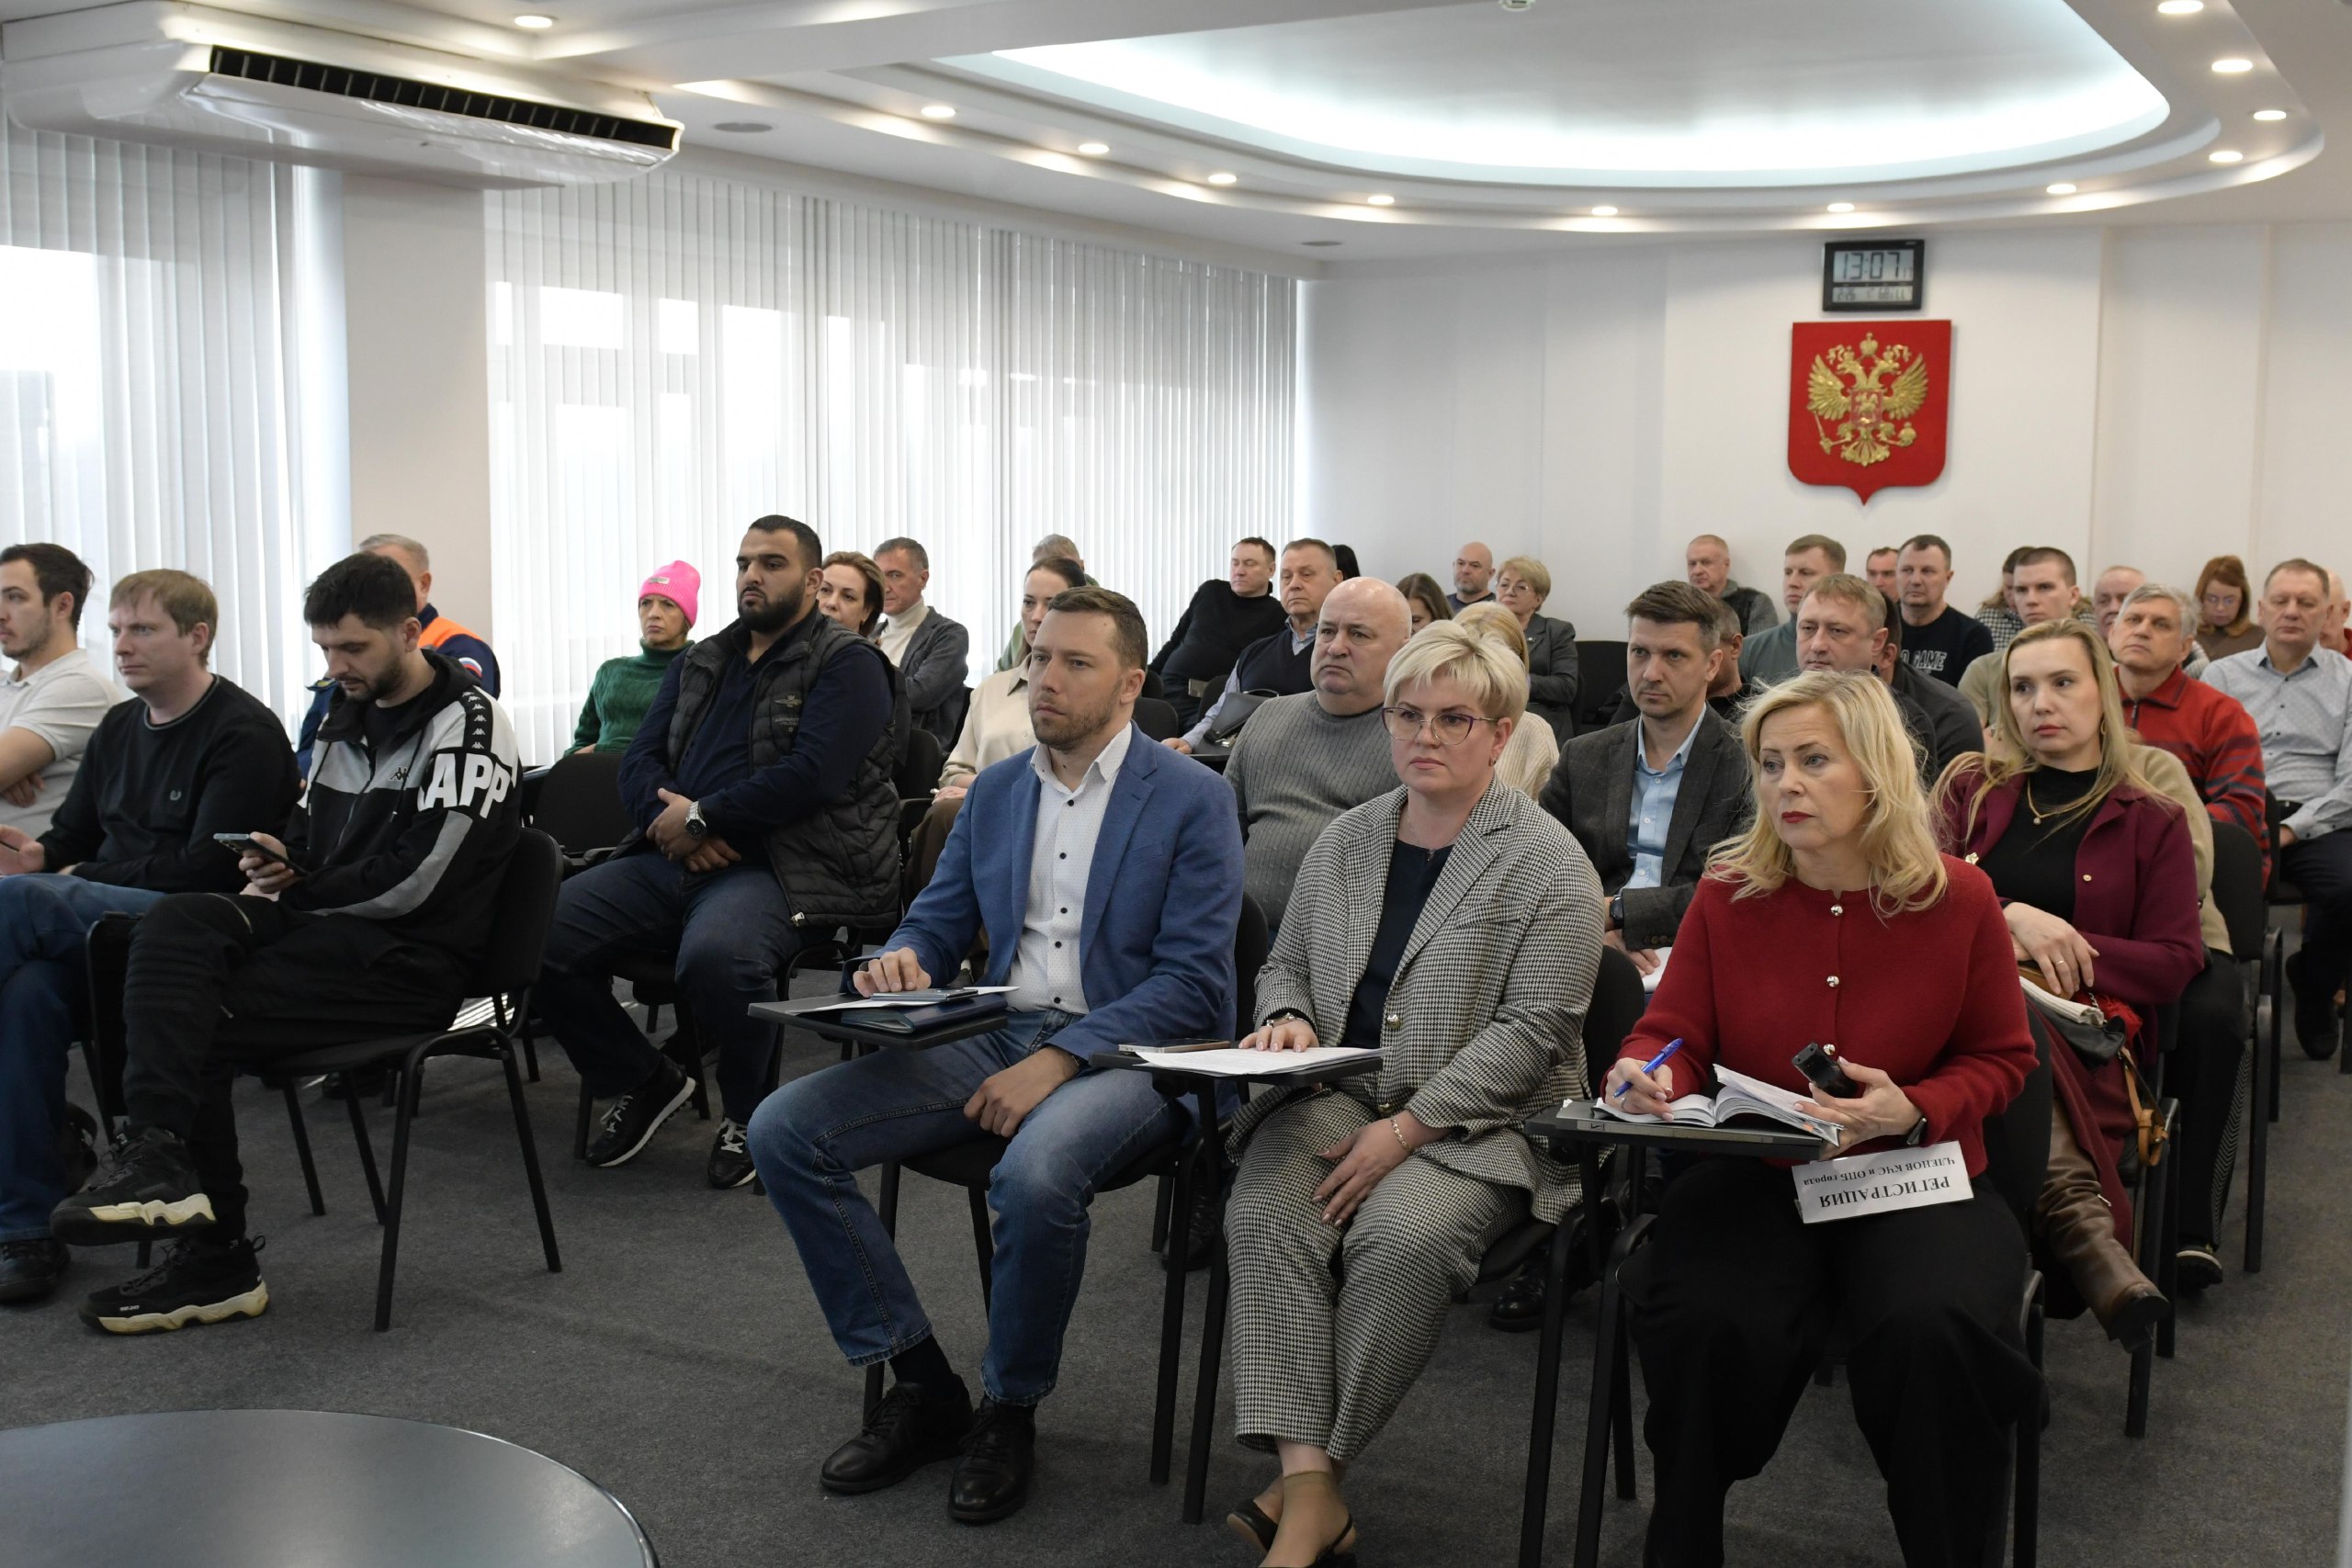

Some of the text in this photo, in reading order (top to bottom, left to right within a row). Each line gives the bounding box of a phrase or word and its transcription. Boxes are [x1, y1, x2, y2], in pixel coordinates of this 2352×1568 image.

[1844, 253, 1900, 278] 13:07
[1913, 650, 1947, 671] GAME
[417, 752, 511, 819] APP
[1877, 1164, 1903, 1176] КЧС
[1905, 1157, 1955, 1171] ЧЛЕНОВ
[1804, 1175, 1838, 1186] города
[1839, 1170, 1867, 1182] ОПБ
[1819, 1177, 1950, 1207] РЕГИСТРАЦИЯ
